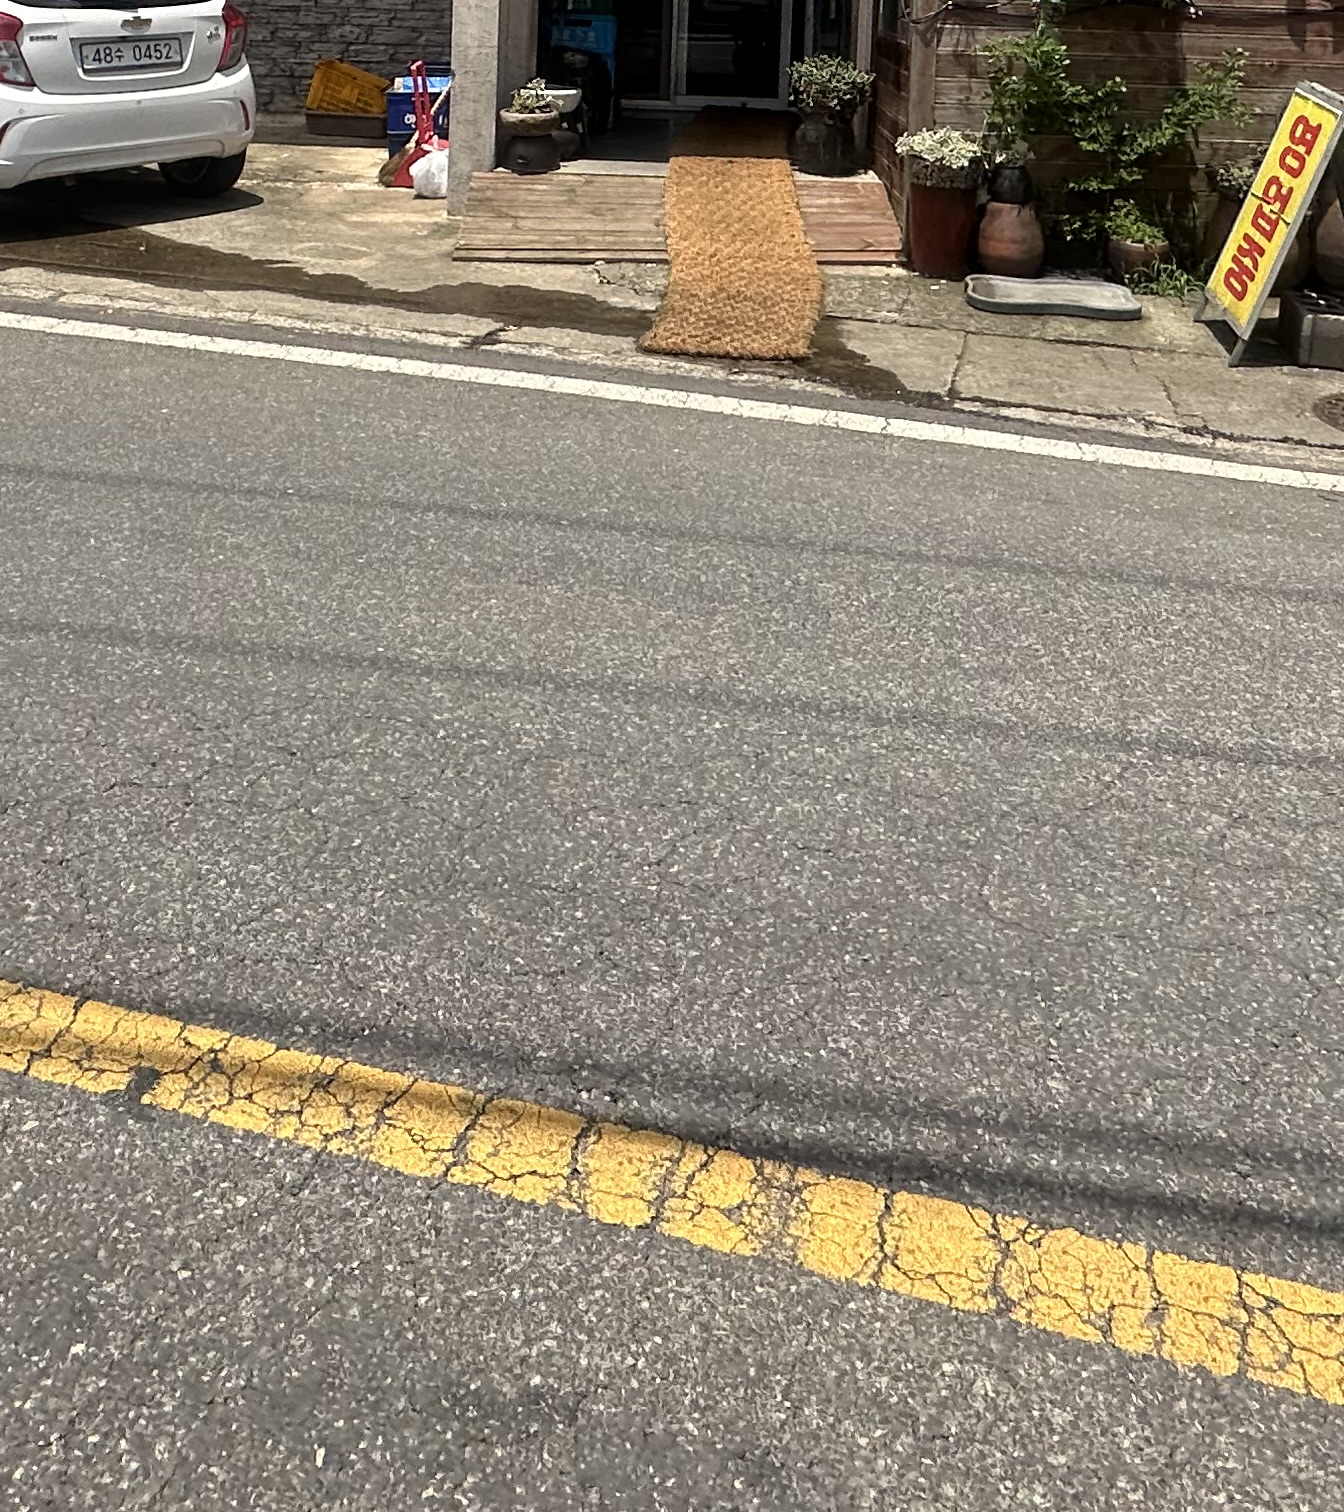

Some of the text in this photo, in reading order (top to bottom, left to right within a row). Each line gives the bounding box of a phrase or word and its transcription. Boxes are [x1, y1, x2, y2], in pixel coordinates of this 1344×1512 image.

[91, 43, 174, 65] 48수 0452
[1223, 114, 1323, 302] 영업중
